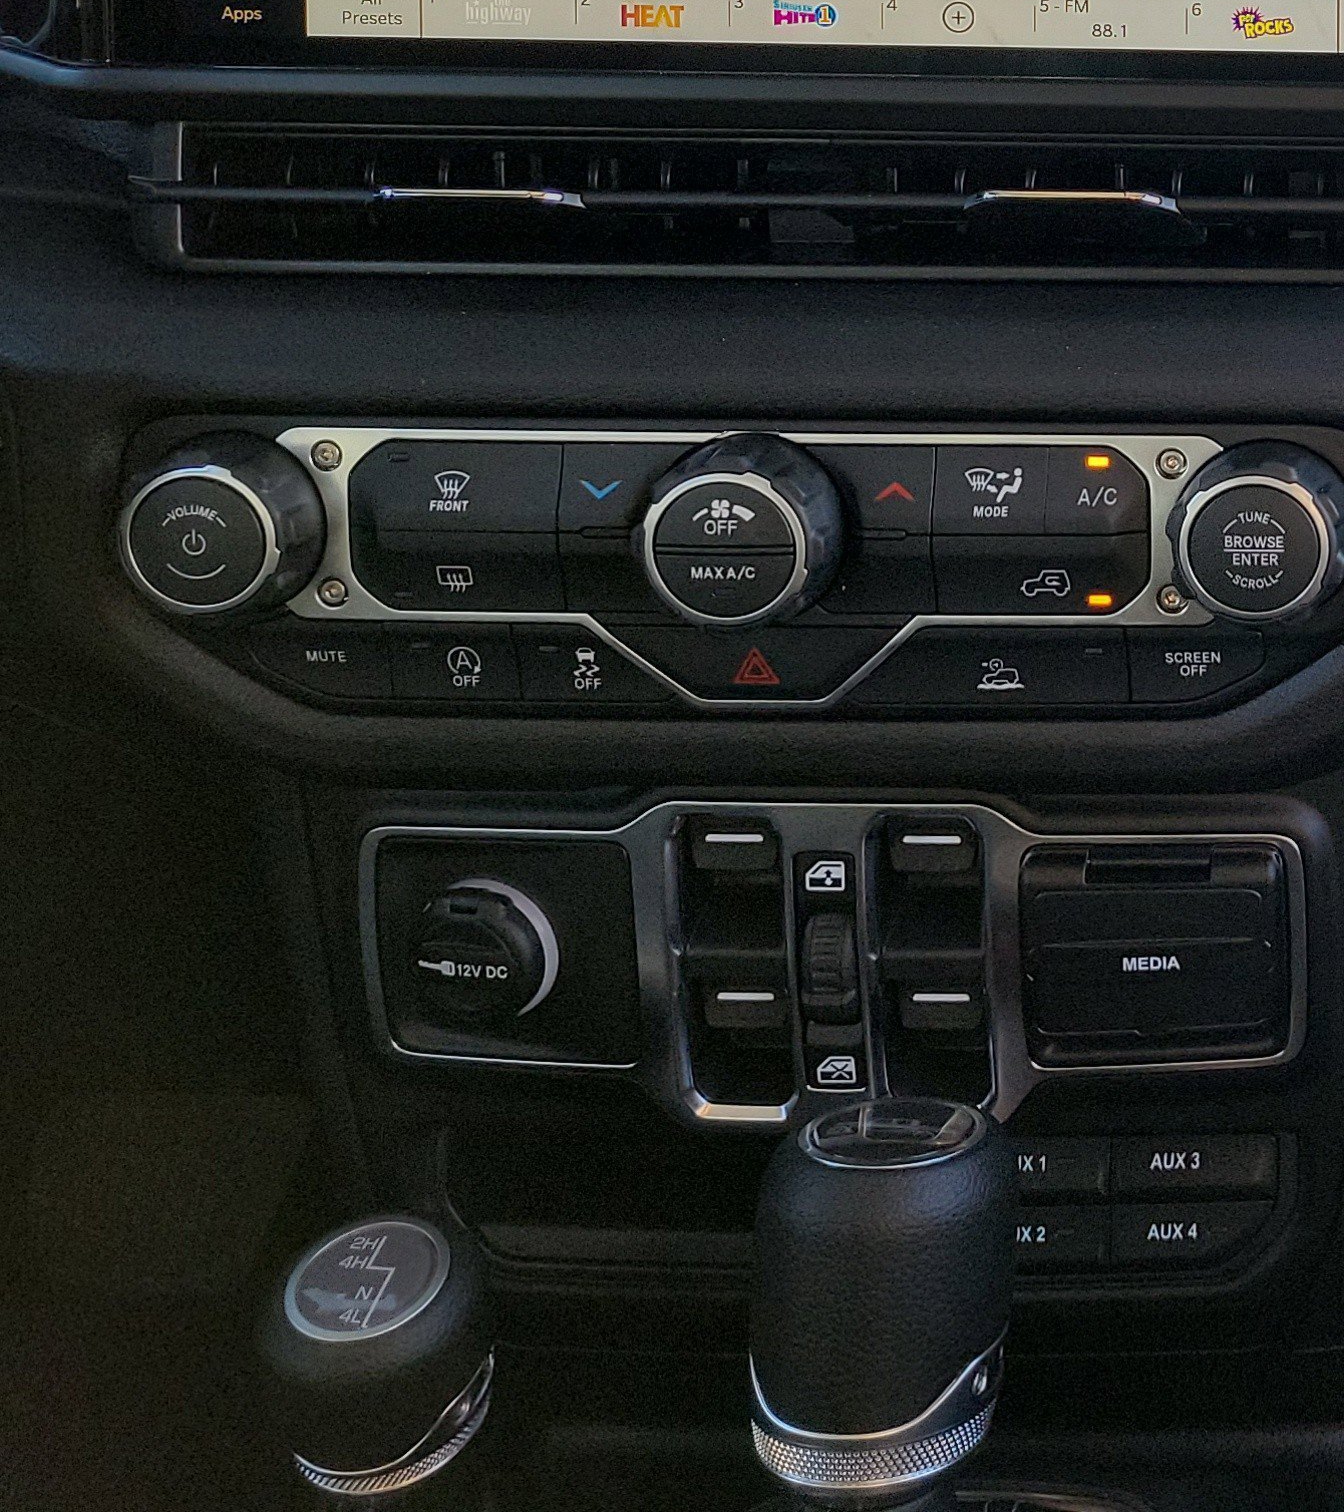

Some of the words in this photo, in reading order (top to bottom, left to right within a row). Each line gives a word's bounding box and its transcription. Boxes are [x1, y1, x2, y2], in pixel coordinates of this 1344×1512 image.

[466, 2, 531, 25] highway
[1040, 0, 1049, 12] 5
[1065, 0, 1088, 13] FM
[1192, 3, 1201, 16] 6
[222, 6, 263, 23] Apps
[342, 10, 402, 25] Presets
[621, 4, 685, 27] HEAT
[1091, 24, 1127, 38] 88.1
[1244, 18, 1293, 39] ROCKS
[1078, 488, 1118, 506] A/C
[167, 505, 218, 521] VOLUME
[429, 500, 469, 513] FRONT
[973, 505, 1009, 518] MODE
[1238, 511, 1271, 524] TUNE
[704, 520, 738, 535] OFF
[1224, 536, 1284, 548] BROWSE
[1233, 554, 1279, 566] ENTER
[690, 567, 724, 580] MAX
[726, 566, 756, 580] A/C
[1233, 575, 1279, 589] SCROLL
[306, 649, 348, 662] MUTE
[1165, 651, 1221, 664] SCREEN
[1180, 664, 1208, 677] OFF
[452, 674, 480, 687] OFF
[574, 677, 602, 690] OFF
[1121, 955, 1180, 971] MEDIA
[457, 963, 482, 978] 12V
[486, 966, 508, 979] DC
[1150, 1152, 1186, 1170] AUX
[1190, 1152, 1200, 1169] 3
[1036, 1226, 1046, 1242] 2
[1147, 1223, 1183, 1241] AUX
[1187, 1222, 1198, 1240] 4
[350, 1237, 378, 1250] 2H
[339, 1256, 368, 1270] 4H
[355, 1287, 373, 1300] N
[339, 1309, 362, 1324] 4L
